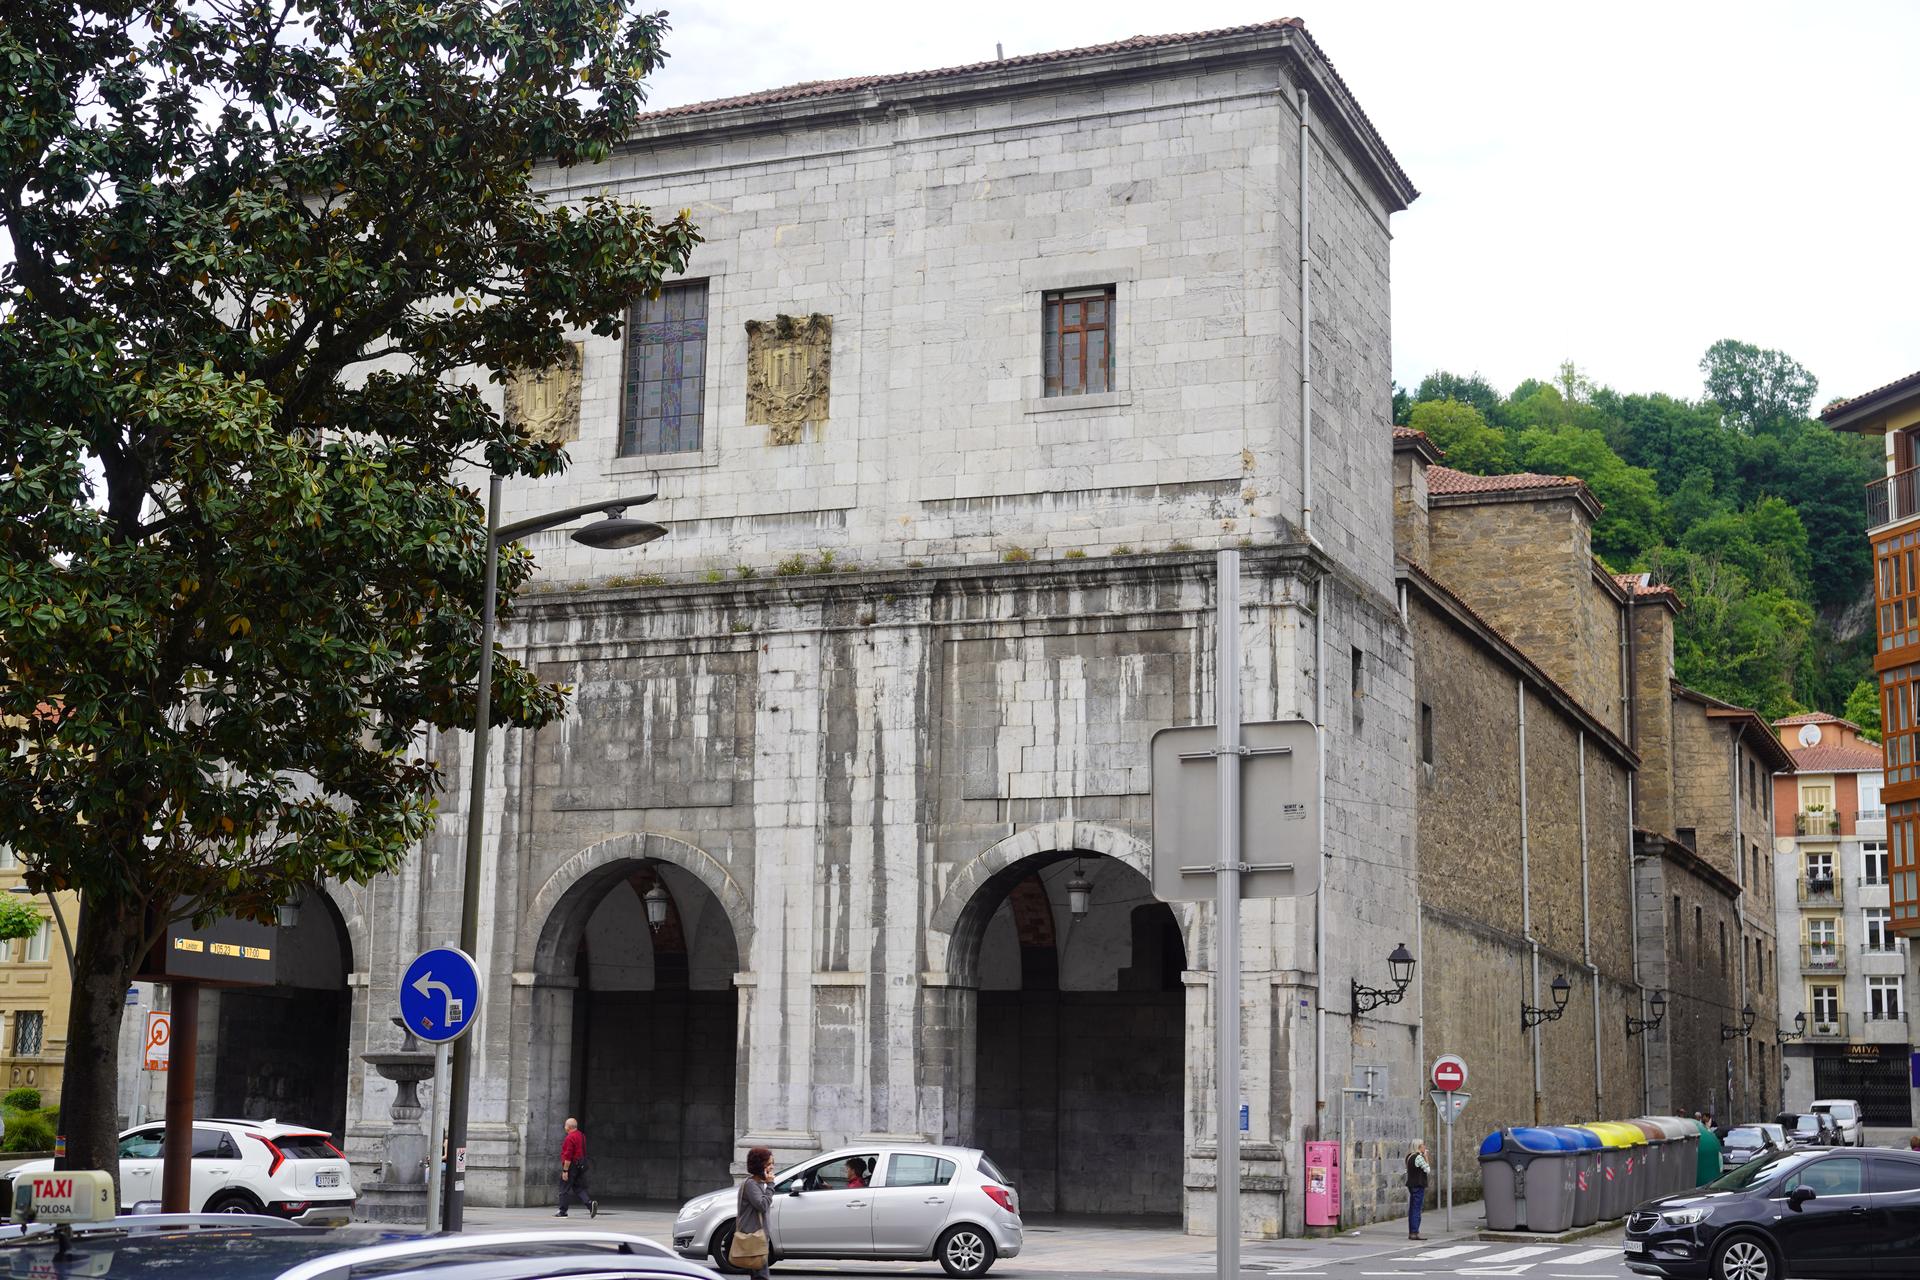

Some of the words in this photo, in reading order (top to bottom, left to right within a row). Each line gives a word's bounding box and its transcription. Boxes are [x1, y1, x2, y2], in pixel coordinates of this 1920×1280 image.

[33, 1179, 73, 1198] TAXI
[101, 1188, 108, 1202] 3
[35, 1204, 72, 1214] TOLOSA
